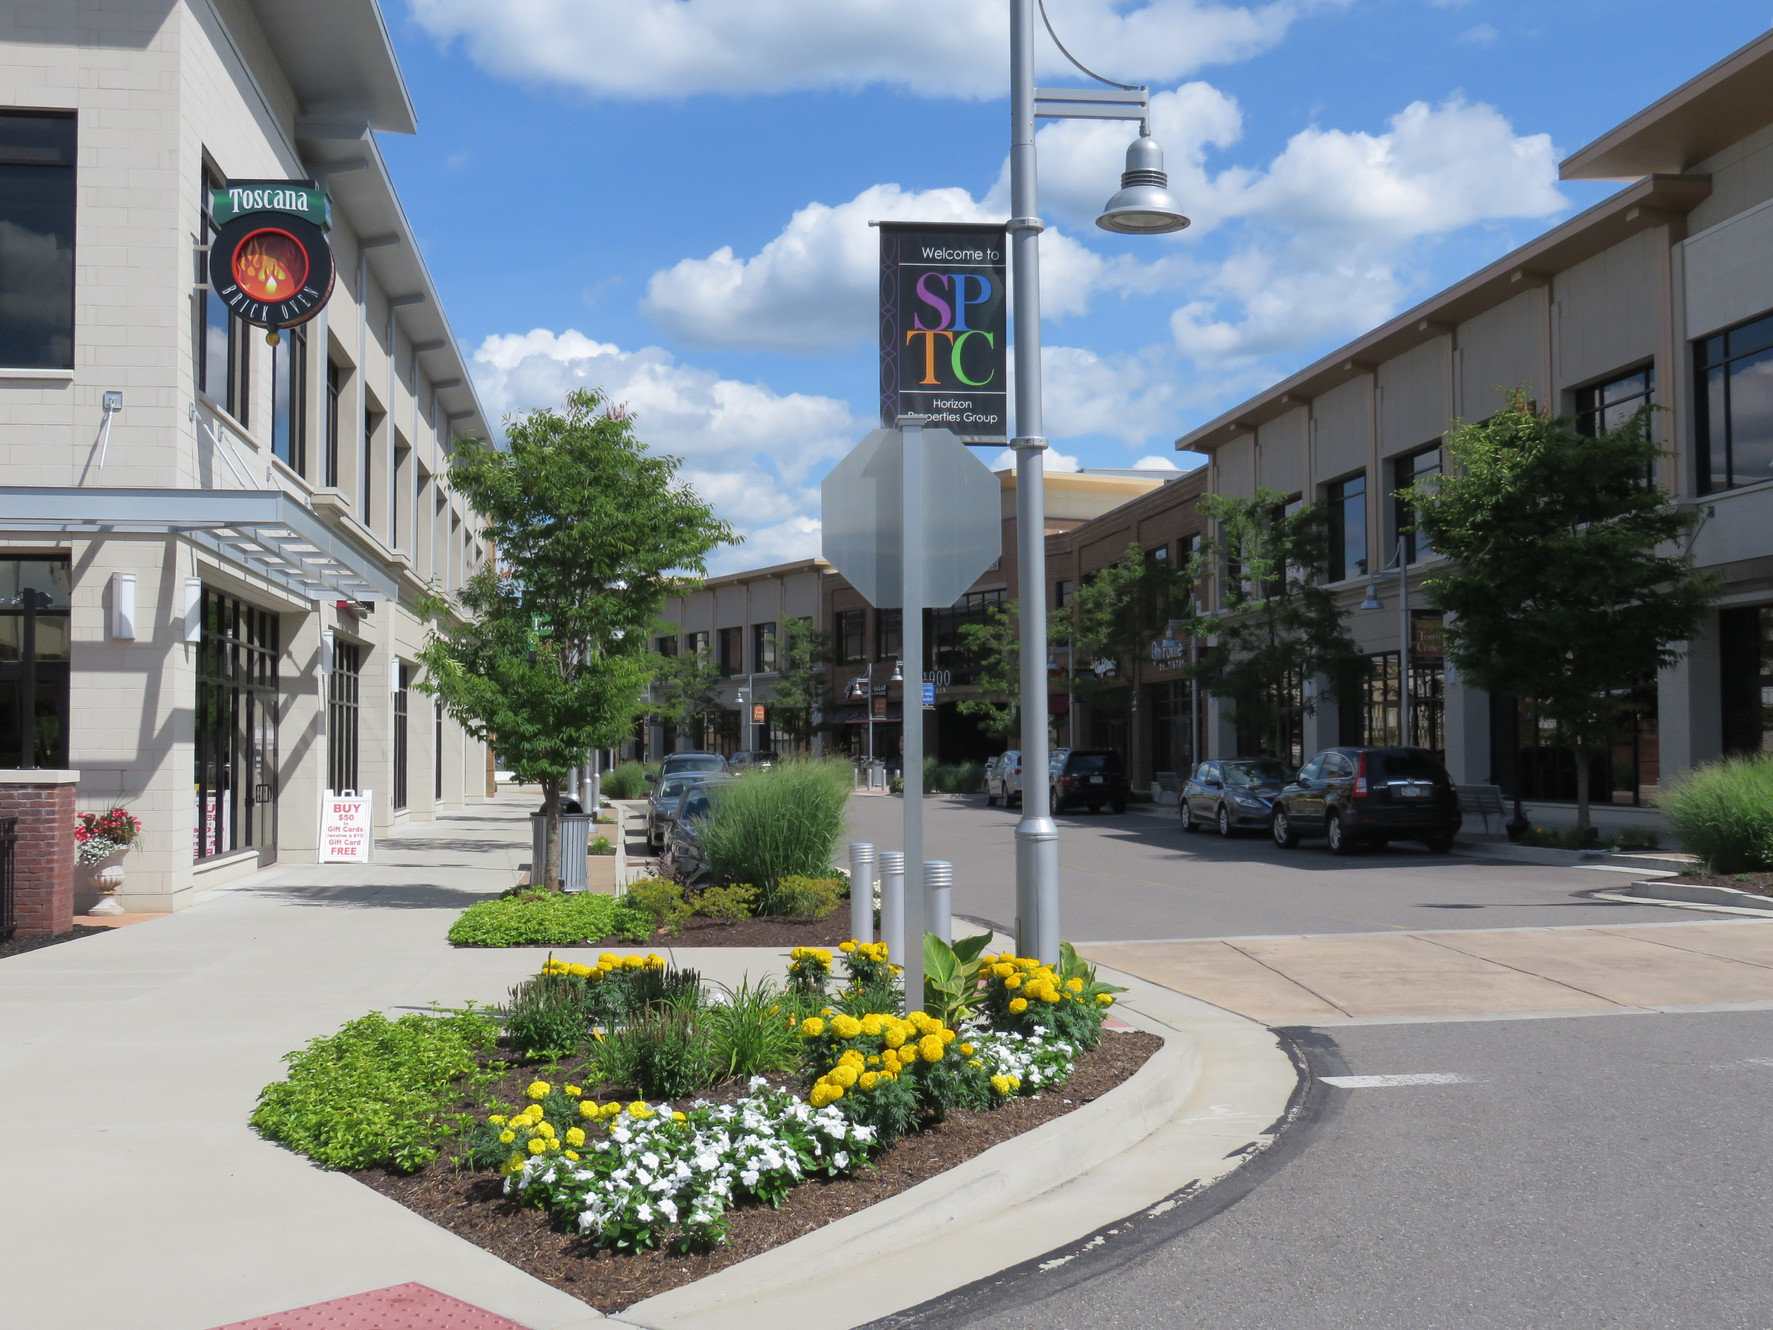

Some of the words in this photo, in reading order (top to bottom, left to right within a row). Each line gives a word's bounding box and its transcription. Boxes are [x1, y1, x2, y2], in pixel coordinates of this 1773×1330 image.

[229, 187, 309, 213] Toscana
[922, 247, 983, 260] Welcome
[987, 249, 1000, 261] to
[222, 284, 269, 322] BRICK
[281, 285, 319, 320] OVEN
[933, 398, 972, 409] Horizon
[907, 411, 960, 424] perties
[963, 411, 998, 424] Group
[333, 804, 361, 813] BUY
[331, 847, 356, 855] FREE
